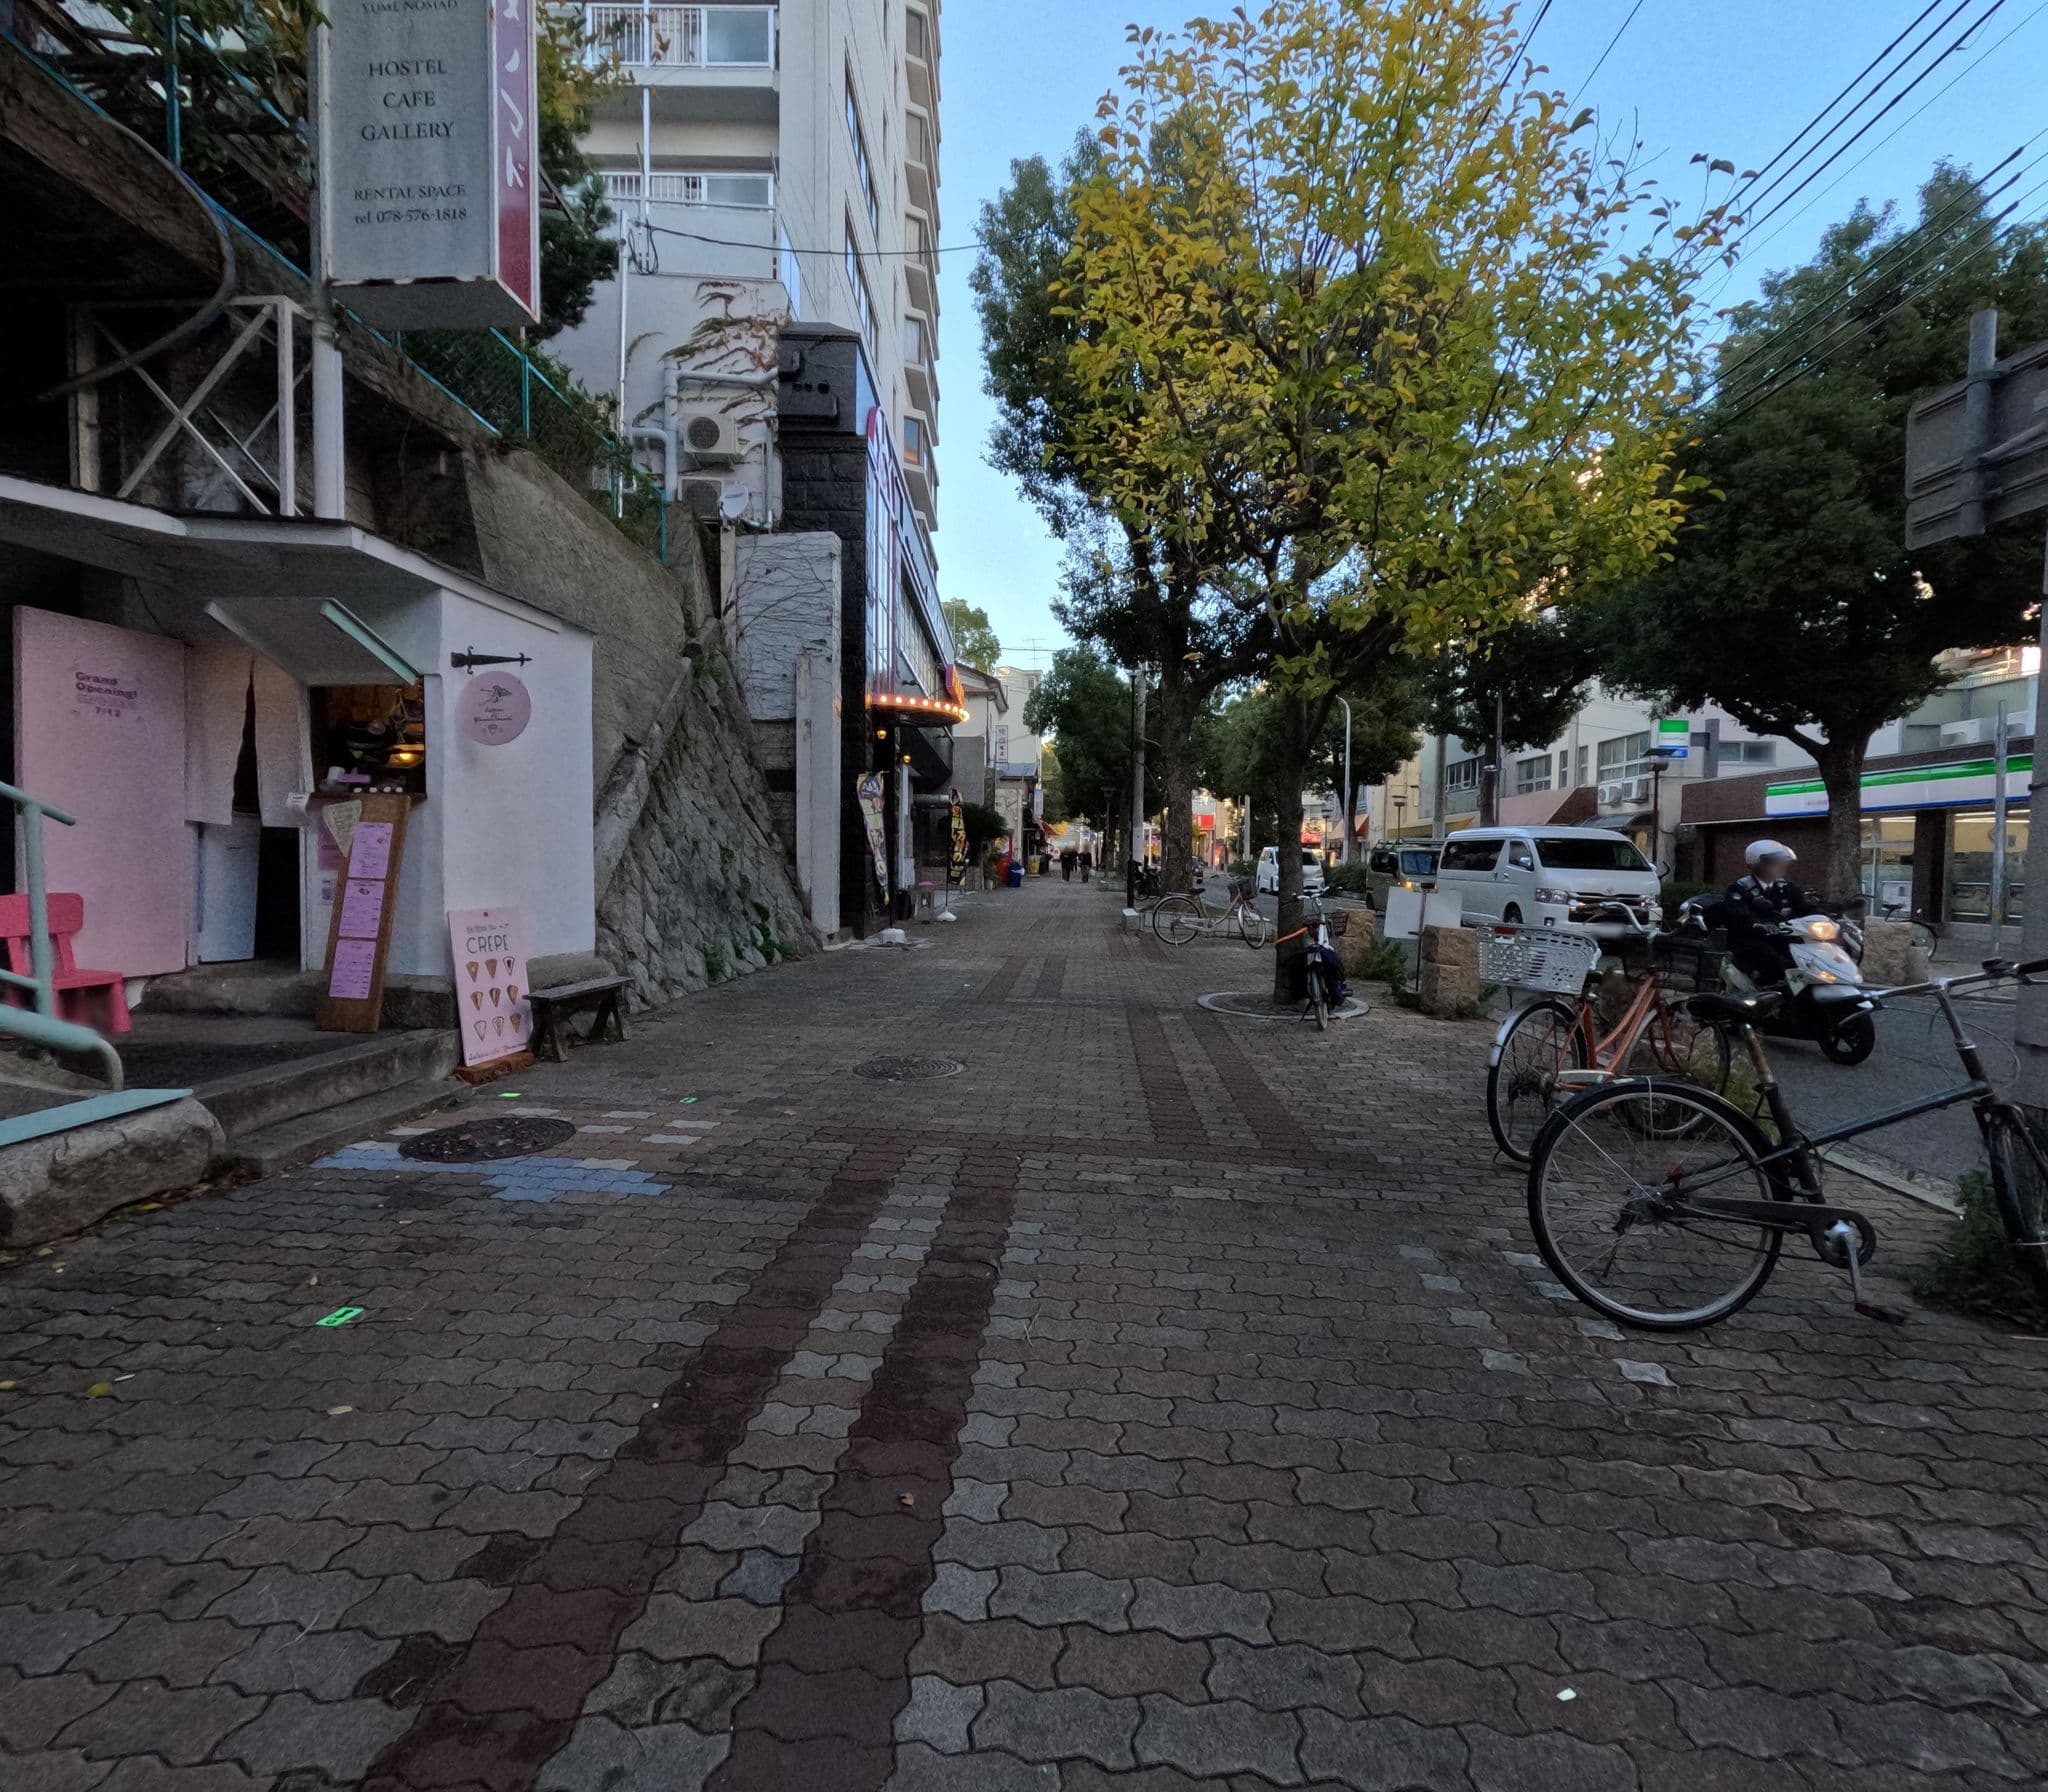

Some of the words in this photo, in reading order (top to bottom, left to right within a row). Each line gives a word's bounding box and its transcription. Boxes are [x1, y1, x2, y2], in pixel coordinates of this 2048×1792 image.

[369, 60, 447, 76] HOSTEL
[383, 91, 437, 108] CAFE
[361, 121, 455, 141] GALLERY
[354, 186, 414, 201] RENTAL
[418, 184, 467, 199] SPACE
[354, 210, 371, 224] tel
[376, 208, 468, 223] 078-576-1818
[76, 672, 118, 685] Grand
